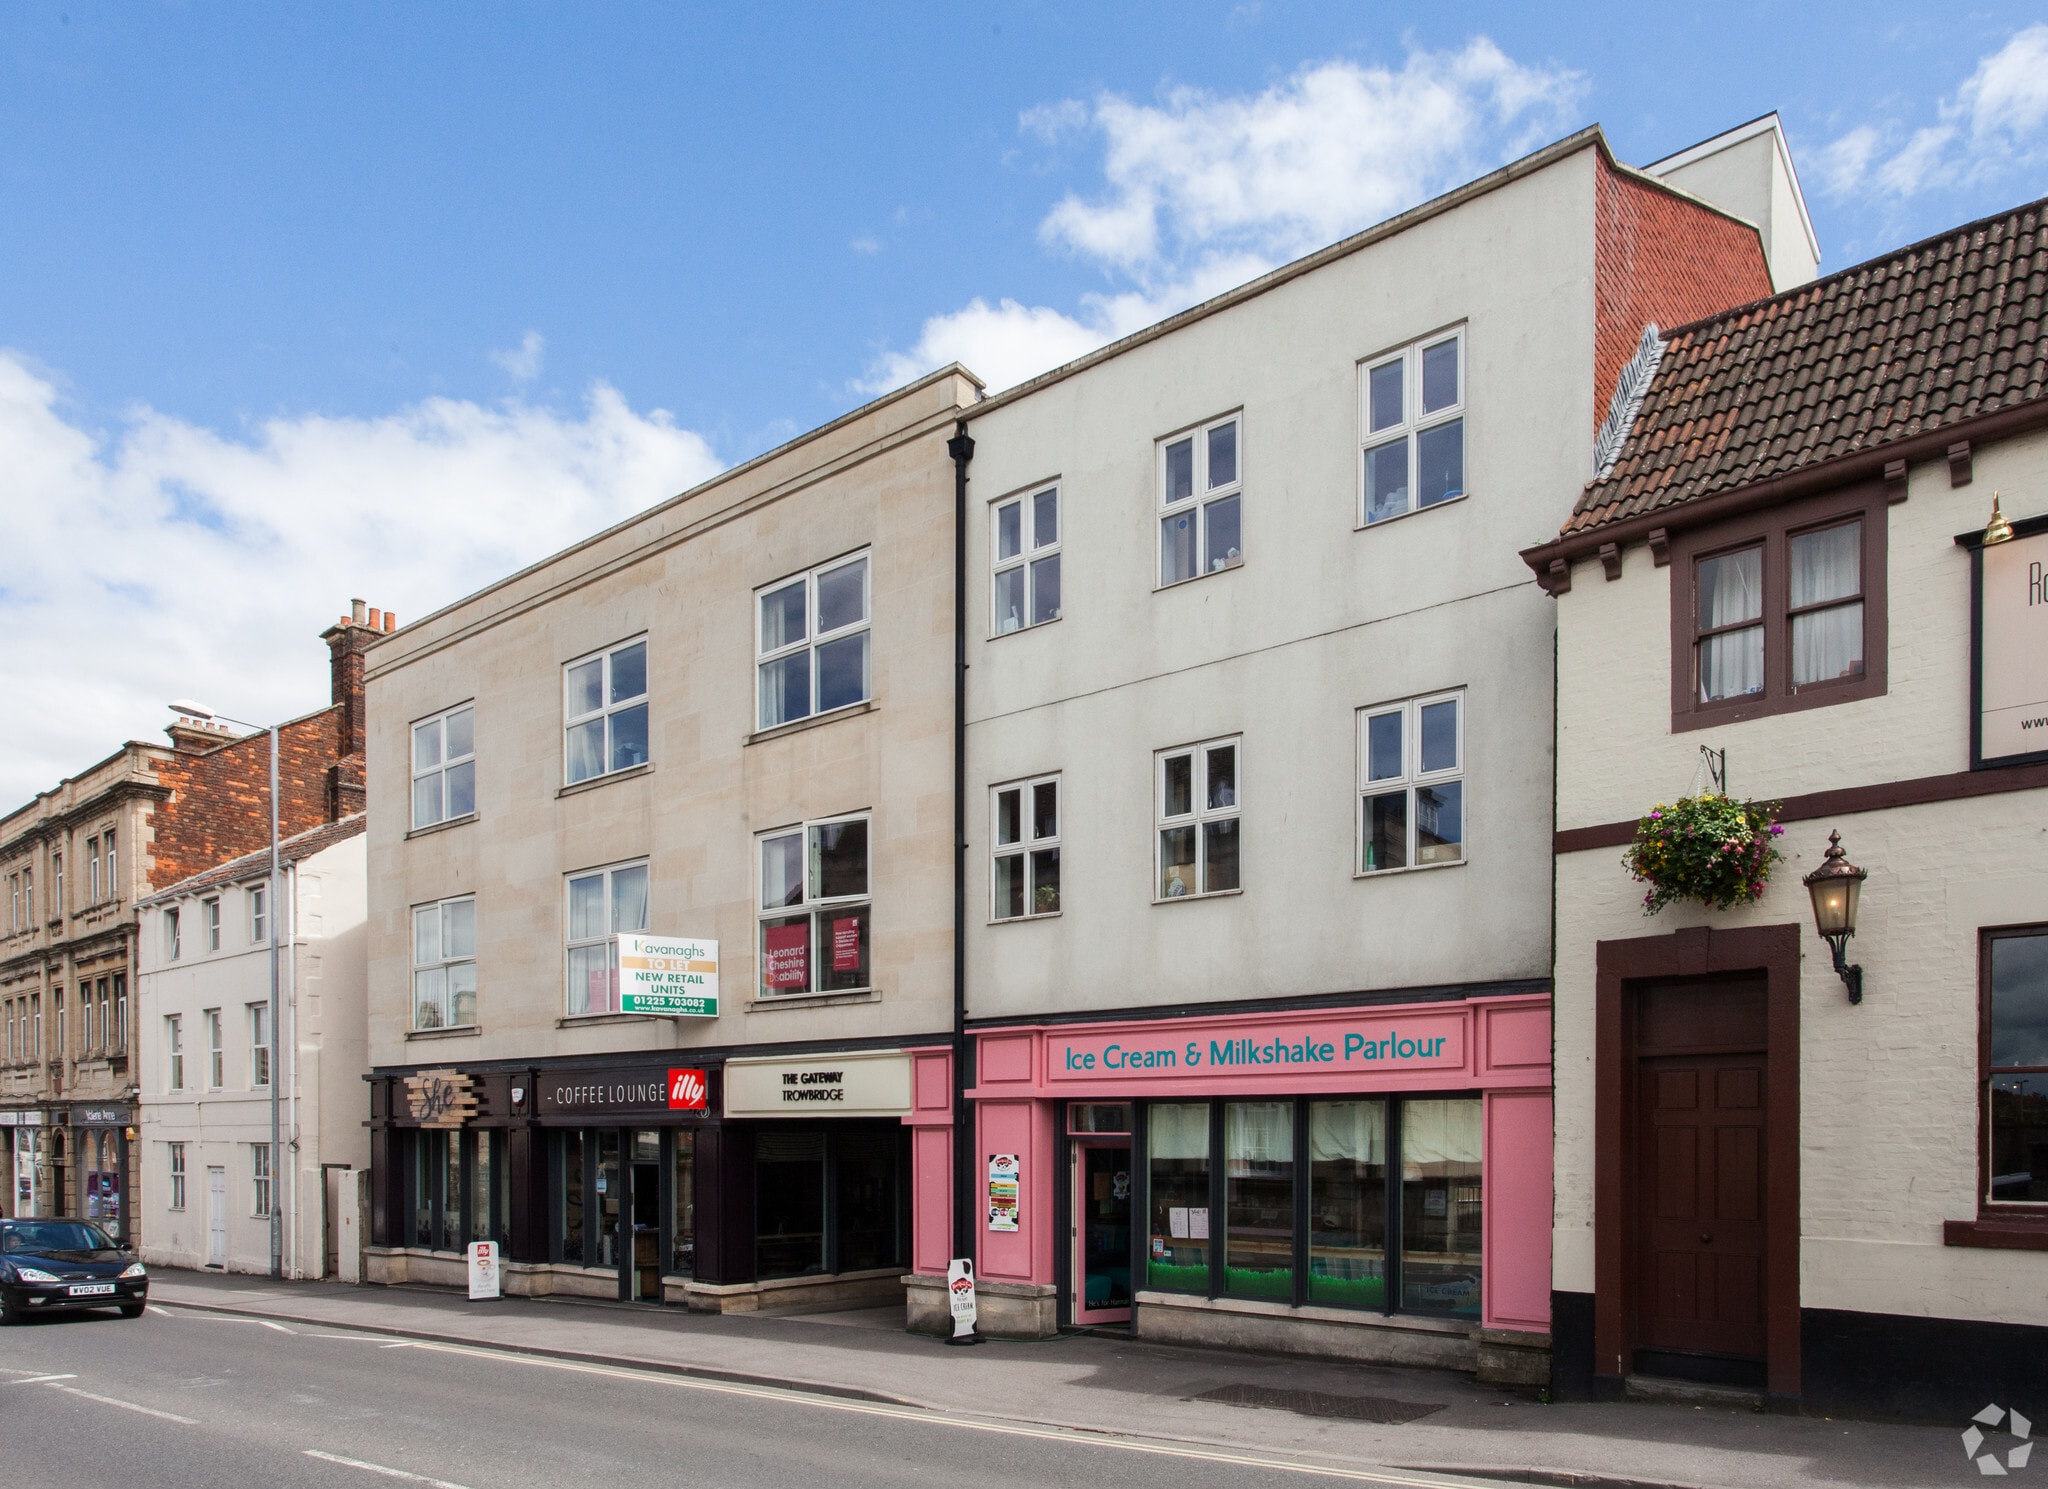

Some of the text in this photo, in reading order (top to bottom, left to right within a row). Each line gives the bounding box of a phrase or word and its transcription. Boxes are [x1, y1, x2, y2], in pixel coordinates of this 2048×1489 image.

[634, 939, 705, 960] Kavanaghs
[769, 945, 805, 958] Leonard
[648, 958, 690, 971] TO LET
[769, 957, 805, 971] Cheshire
[635, 972, 704, 984] NEW RETAIL
[651, 985, 685, 995] UNITS
[634, 996, 705, 1007] 01225 703082
[634, 1006, 705, 1014] www.kavanaghs.co.uk
[1066, 1031, 1446, 1070] Ice Cream & Milkshake Parlour
[782, 1072, 843, 1084] THE GATEWAY
[556, 1086, 604, 1104] COFFEE
[609, 1083, 665, 1103] LOUNGE
[672, 1074, 705, 1106] illy
[782, 1089, 844, 1101] TROWBRIDGE
[96, 1285, 111, 1293] VUE
